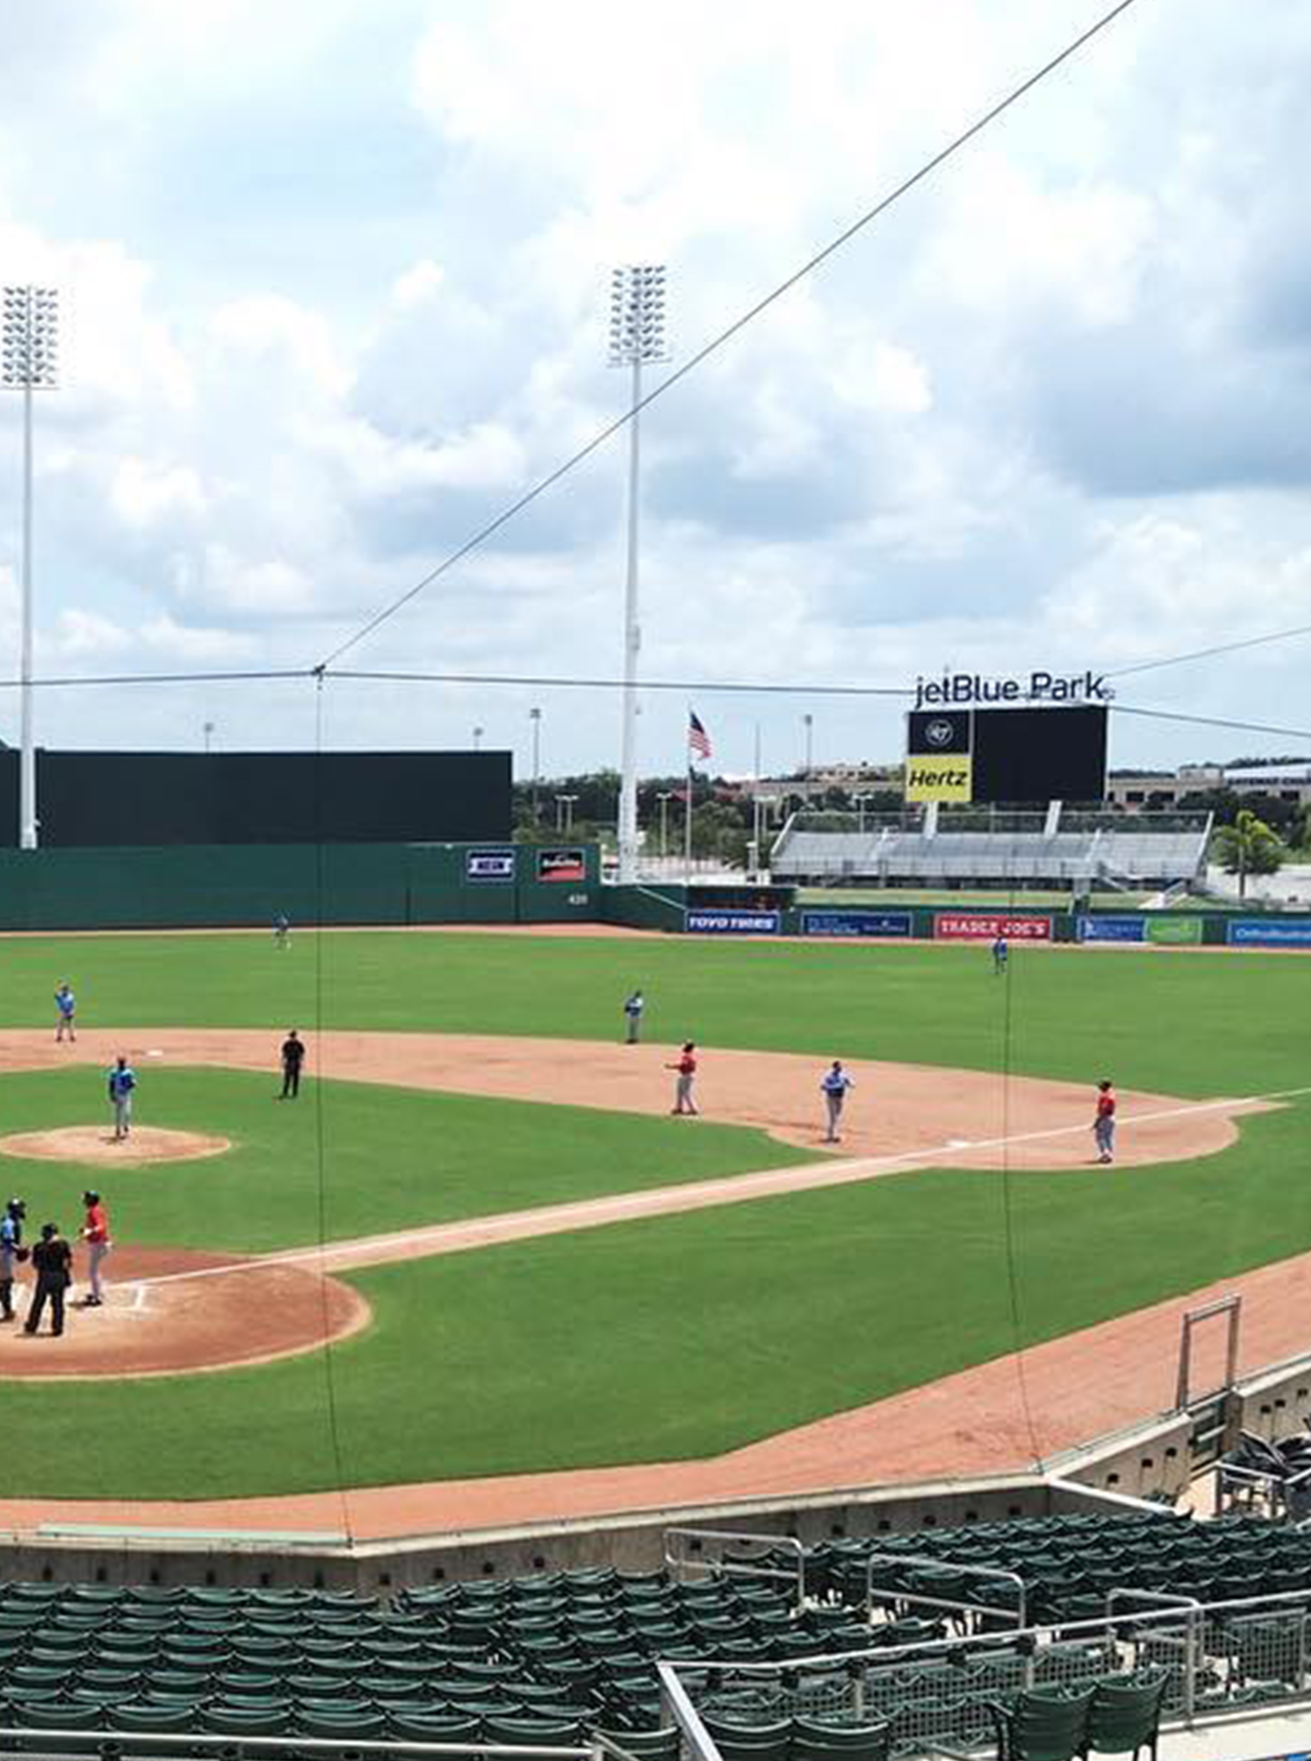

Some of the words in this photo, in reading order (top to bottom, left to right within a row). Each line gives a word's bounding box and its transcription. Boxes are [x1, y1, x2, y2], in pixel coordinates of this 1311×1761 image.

[915, 674, 1020, 711] jetBlue
[1030, 671, 1105, 701] Park
[908, 769, 968, 787] Hertz
[689, 916, 729, 930] TOYO
[730, 916, 776, 930] TIRES
[941, 919, 999, 933] TRADER
[1002, 921, 1047, 935] JOE'S
